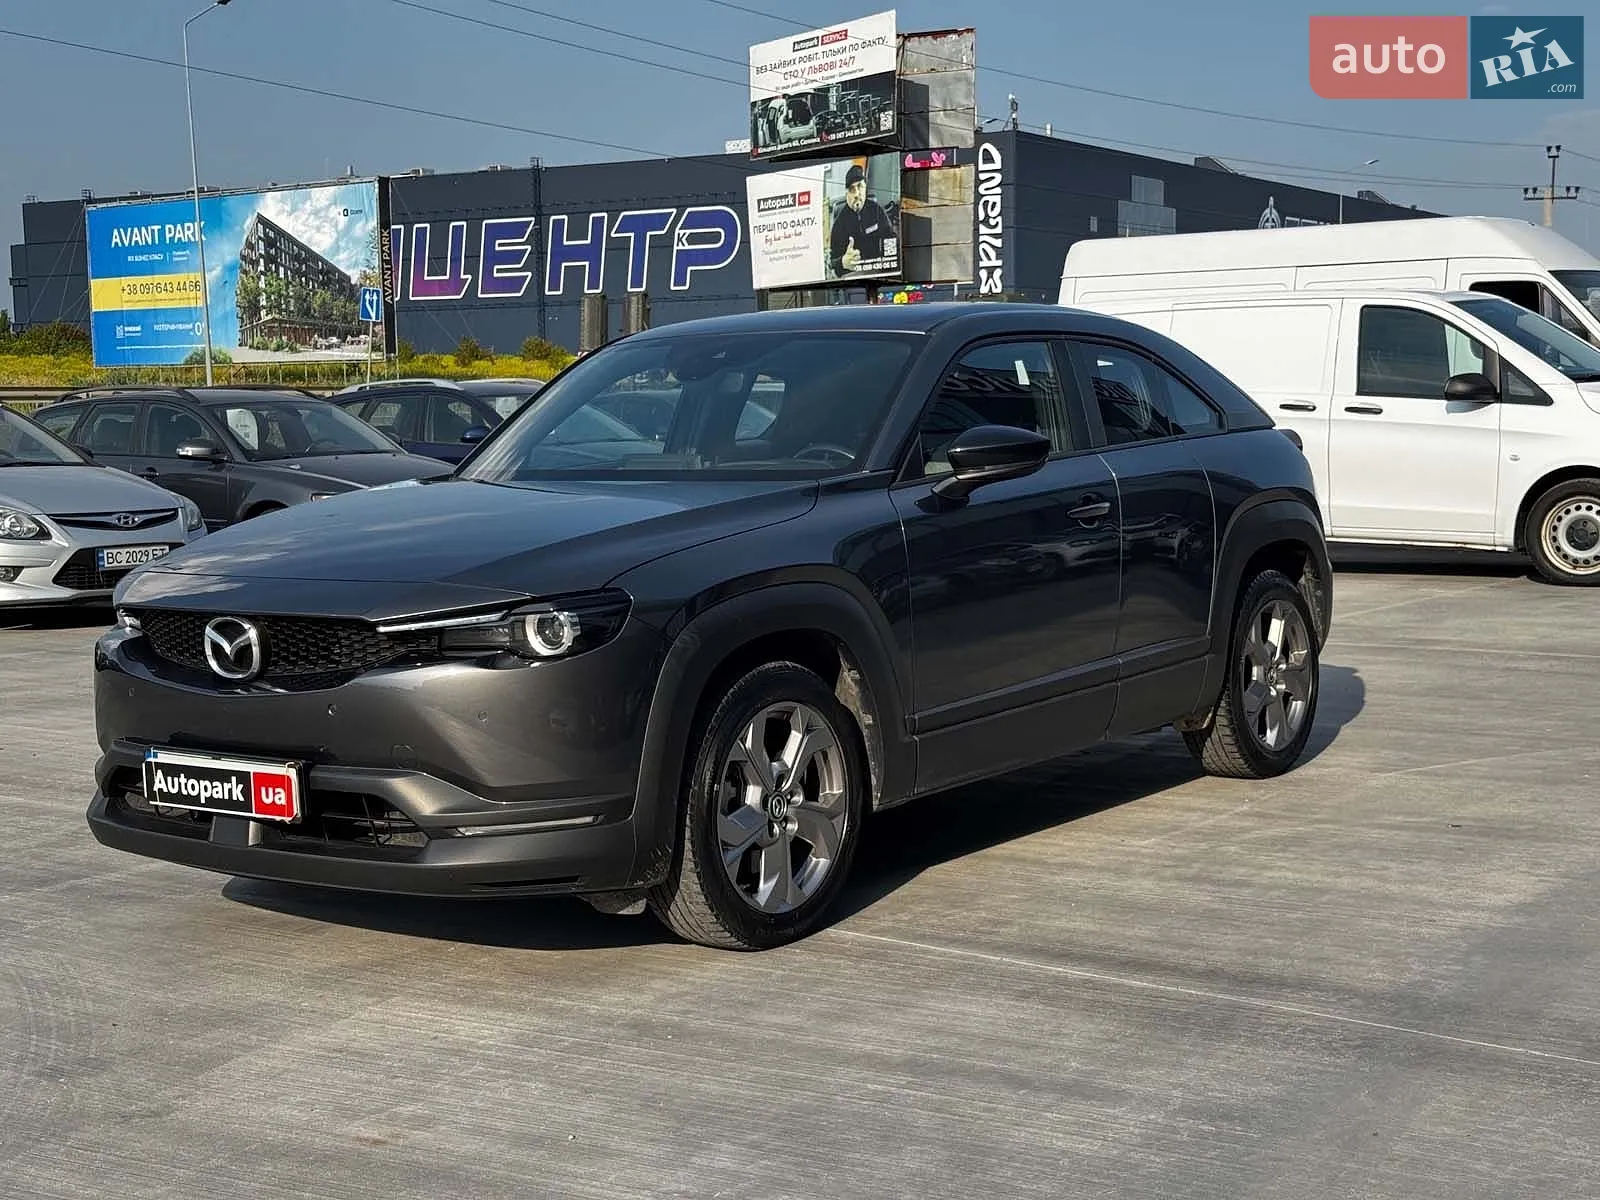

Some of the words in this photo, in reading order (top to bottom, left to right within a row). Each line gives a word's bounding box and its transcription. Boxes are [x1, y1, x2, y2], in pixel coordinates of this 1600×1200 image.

[755, 64, 768, 75] БЕЗ
[769, 57, 796, 72] ЗАЙВИХ
[821, 48, 848, 60] ТІЛЬКИ
[848, 45, 860, 55] ПО
[860, 36, 889, 49] ФАКТУ.
[783, 69, 799, 81] СТО
[800, 67, 806, 78] У
[807, 61, 837, 75] ЛЬВОВІ
[838, 56, 856, 69] 24/7
[759, 196, 795, 211] Autopark
[111, 225, 162, 248] AVANT
[165, 221, 206, 244] PARK
[753, 222, 776, 234] ПЕРШІ
[776, 221, 788, 231] ПО
[789, 216, 818, 229] ФАКТУ.
[382, 228, 391, 261] PARK
[121, 284, 138, 296] +38
[139, 282, 155, 295] 097
[155, 281, 175, 294] 643
[176, 280, 187, 292] 44
[188, 280, 201, 292] 66
[384, 262, 394, 304] AVANT
[106, 551, 122, 565] BC
[125, 549, 150, 564] 2029
[153, 769, 245, 803] Autopark
[260, 786, 287, 805] ua
